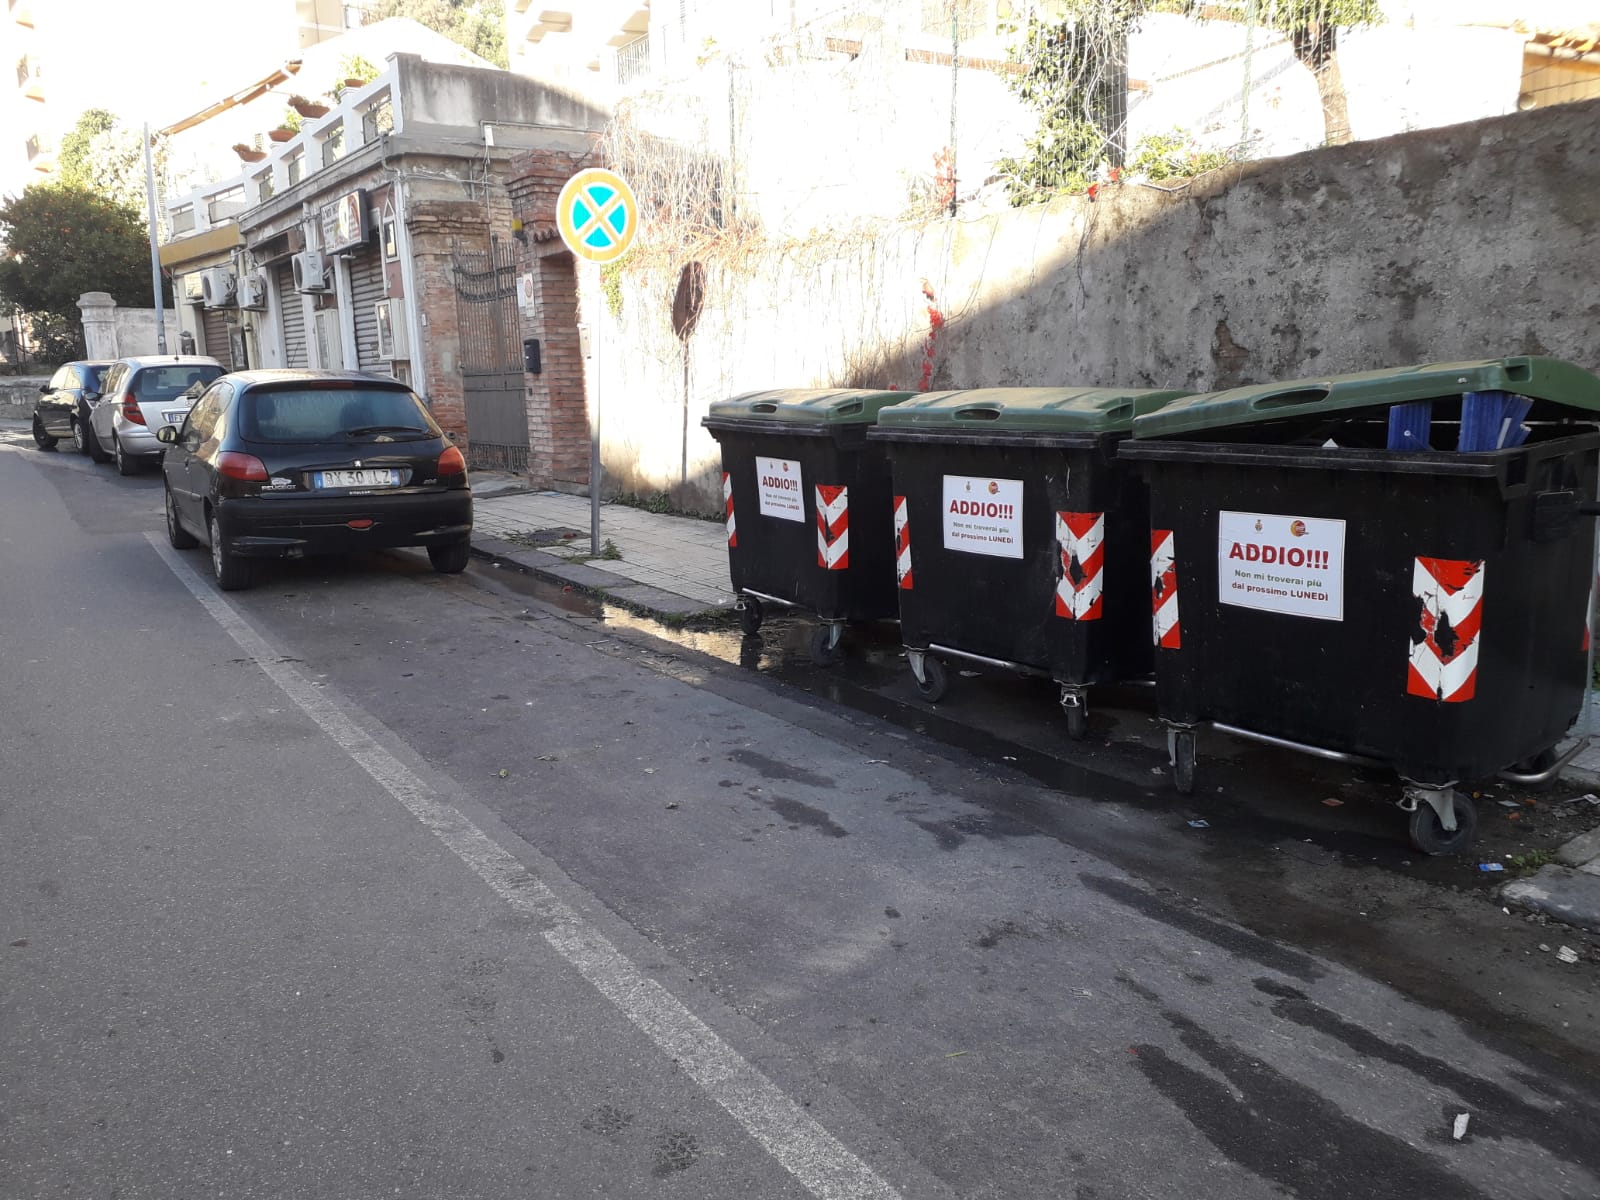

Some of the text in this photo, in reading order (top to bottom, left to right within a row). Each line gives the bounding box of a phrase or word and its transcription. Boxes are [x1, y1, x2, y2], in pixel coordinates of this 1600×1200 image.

[763, 476, 798, 492] ADDIO!!!
[950, 499, 1013, 519] ADDIO!!!
[1229, 542, 1329, 570] ADDIO!!!
[1235, 569, 1322, 587] Non mi troverai più
[1232, 582, 1245, 590] dal
[1247, 584, 1288, 596] prossimo
